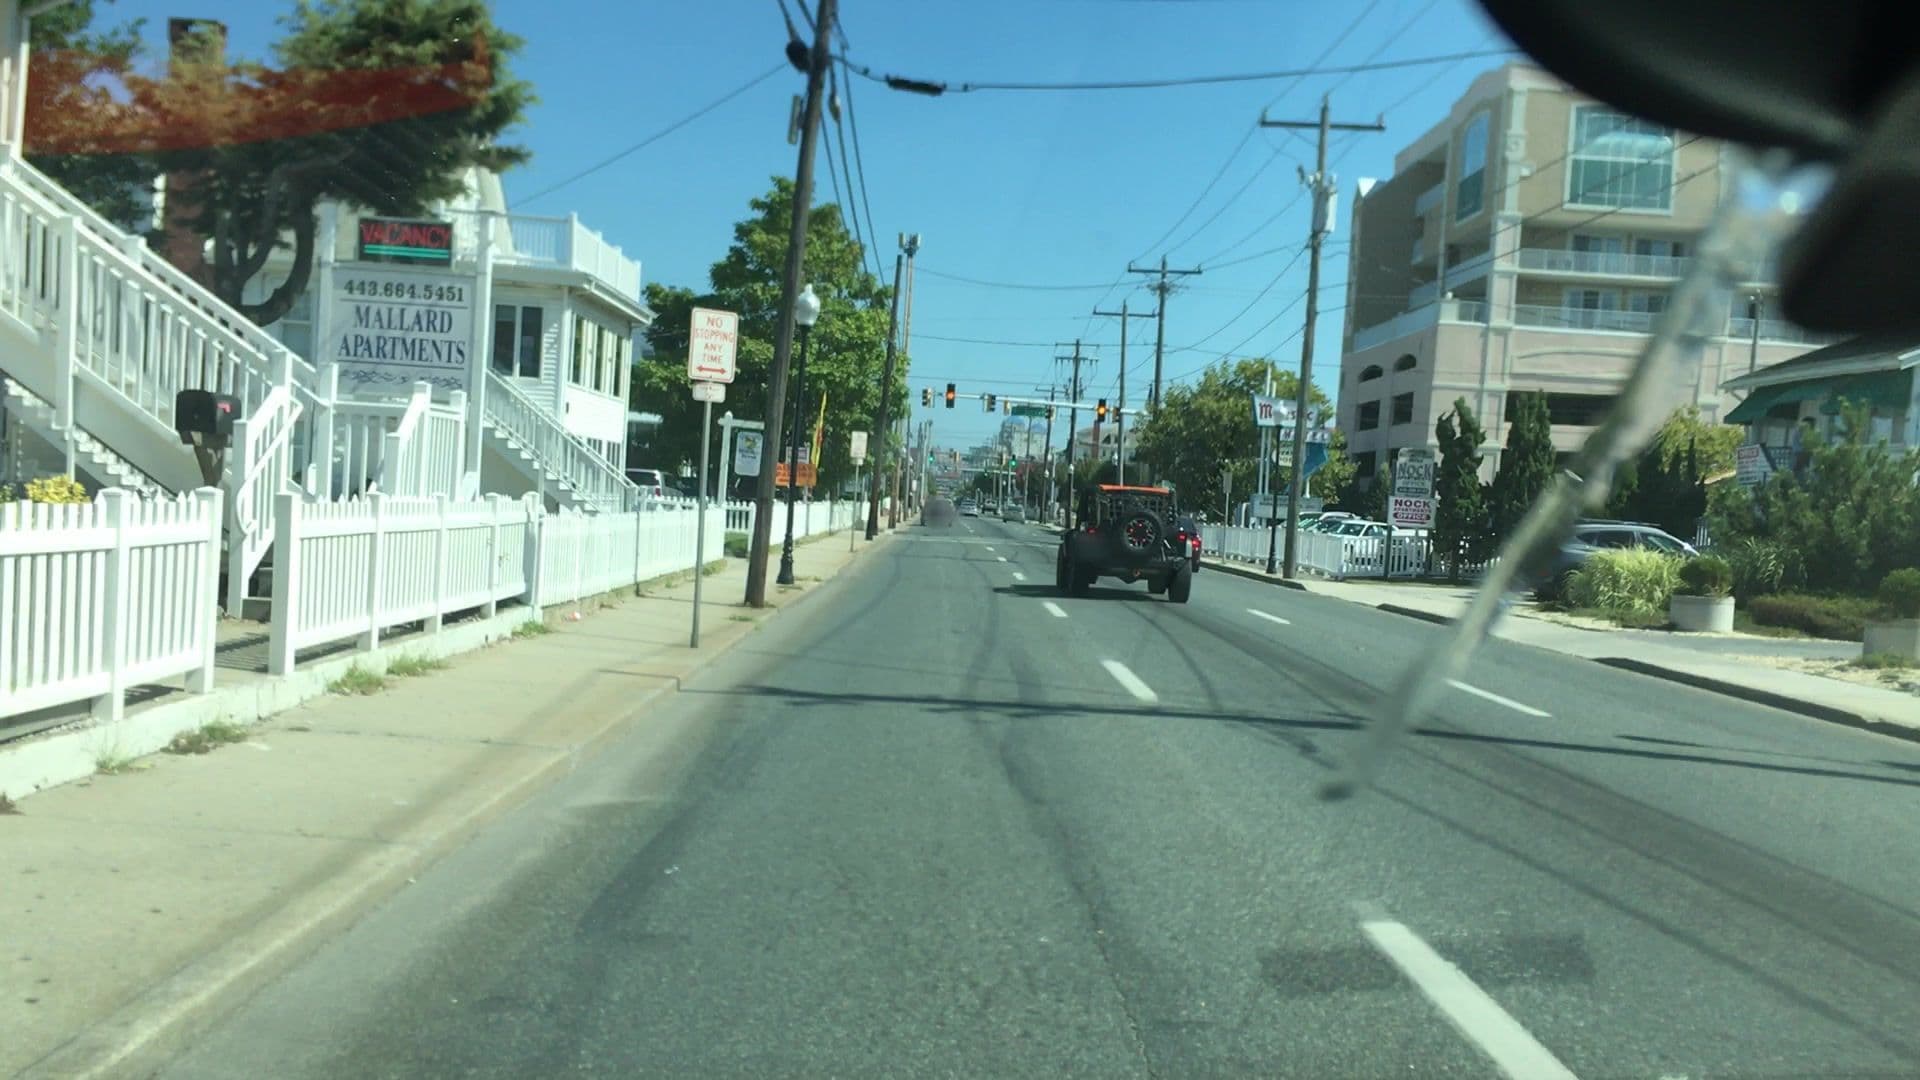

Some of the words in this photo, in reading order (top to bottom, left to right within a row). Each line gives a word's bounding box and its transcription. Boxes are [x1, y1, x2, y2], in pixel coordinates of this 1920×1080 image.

[360, 223, 451, 247] VACANCY
[344, 279, 465, 303] 443.664.5451
[353, 304, 453, 334] MALLARD
[706, 316, 723, 329] NO
[694, 328, 735, 344] STOPPING
[337, 333, 466, 365] APARTMENTS
[704, 342, 723, 353] ANY
[703, 353, 722, 364] TIME
[1398, 463, 1432, 480] NOCK
[1394, 499, 1431, 508] NOCK
[1399, 511, 1426, 521] OFFICE
